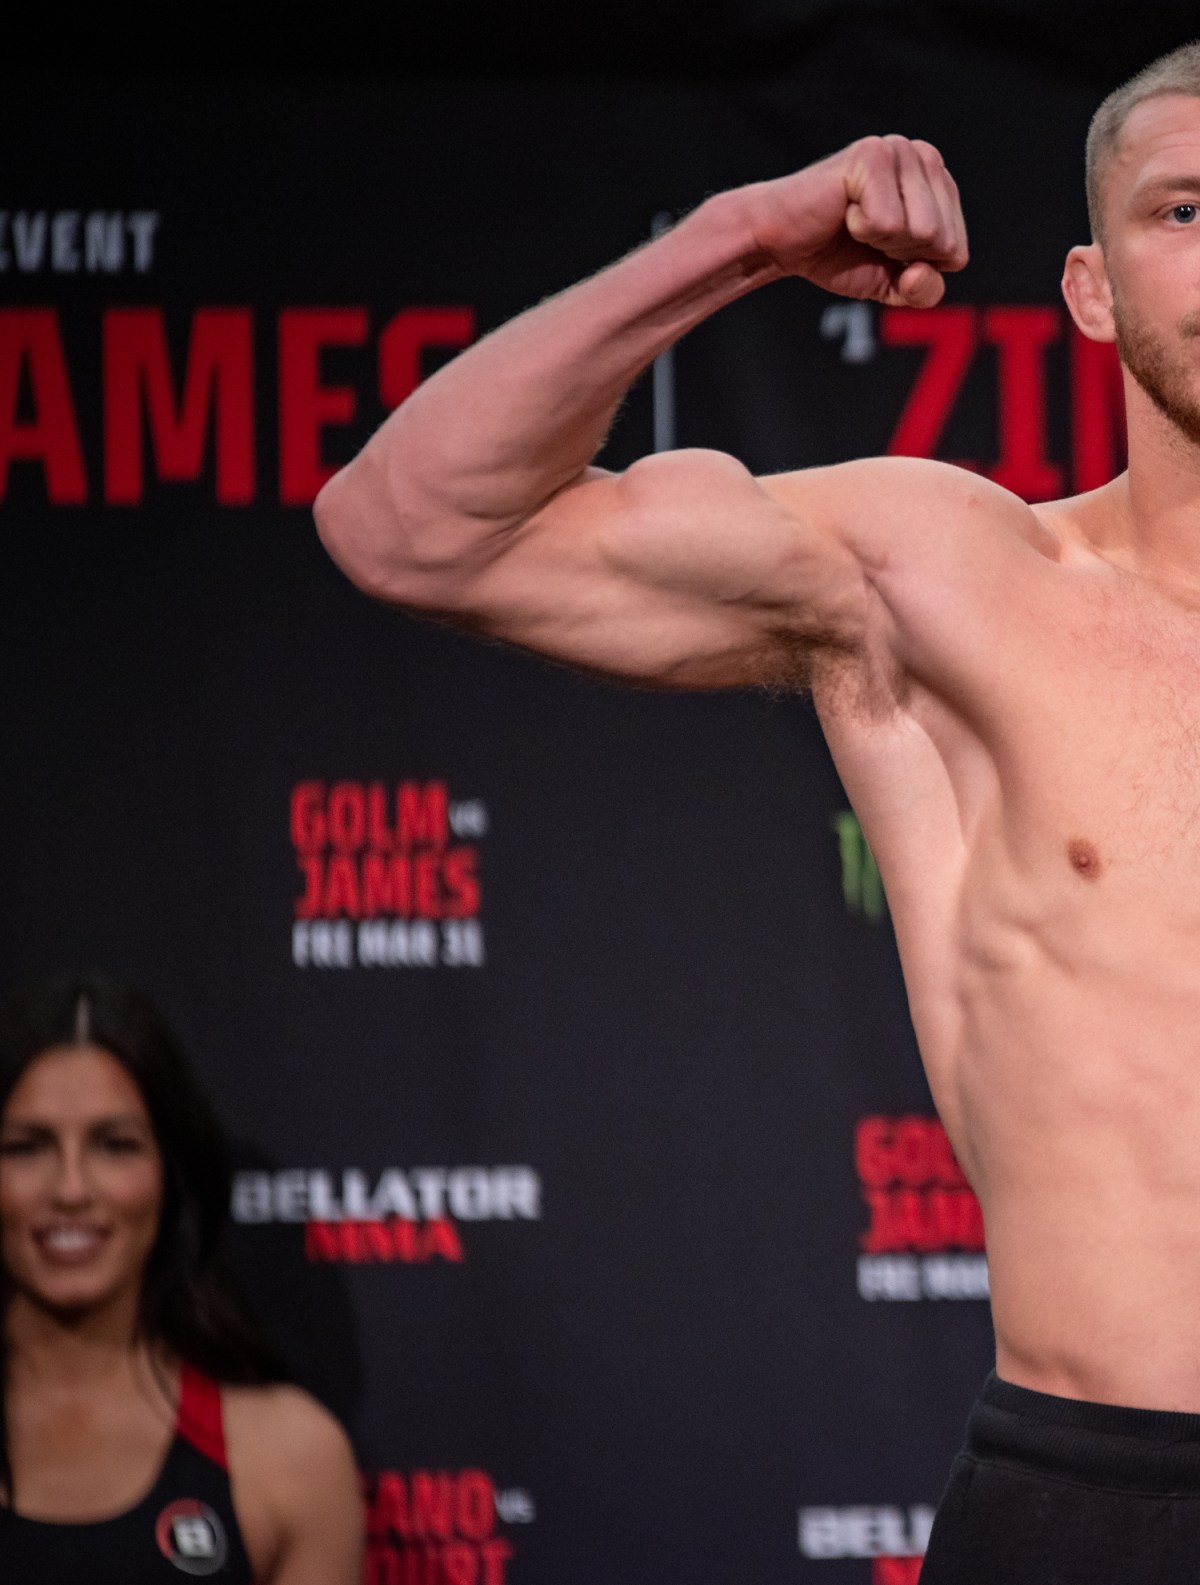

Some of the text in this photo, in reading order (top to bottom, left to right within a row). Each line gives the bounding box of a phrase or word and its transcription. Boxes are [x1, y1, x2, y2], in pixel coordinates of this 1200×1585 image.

[291, 778, 449, 850] GOLM
[295, 848, 480, 920] JAMES
[231, 1165, 542, 1223] BELLATOR
[305, 1219, 465, 1264] MMA
